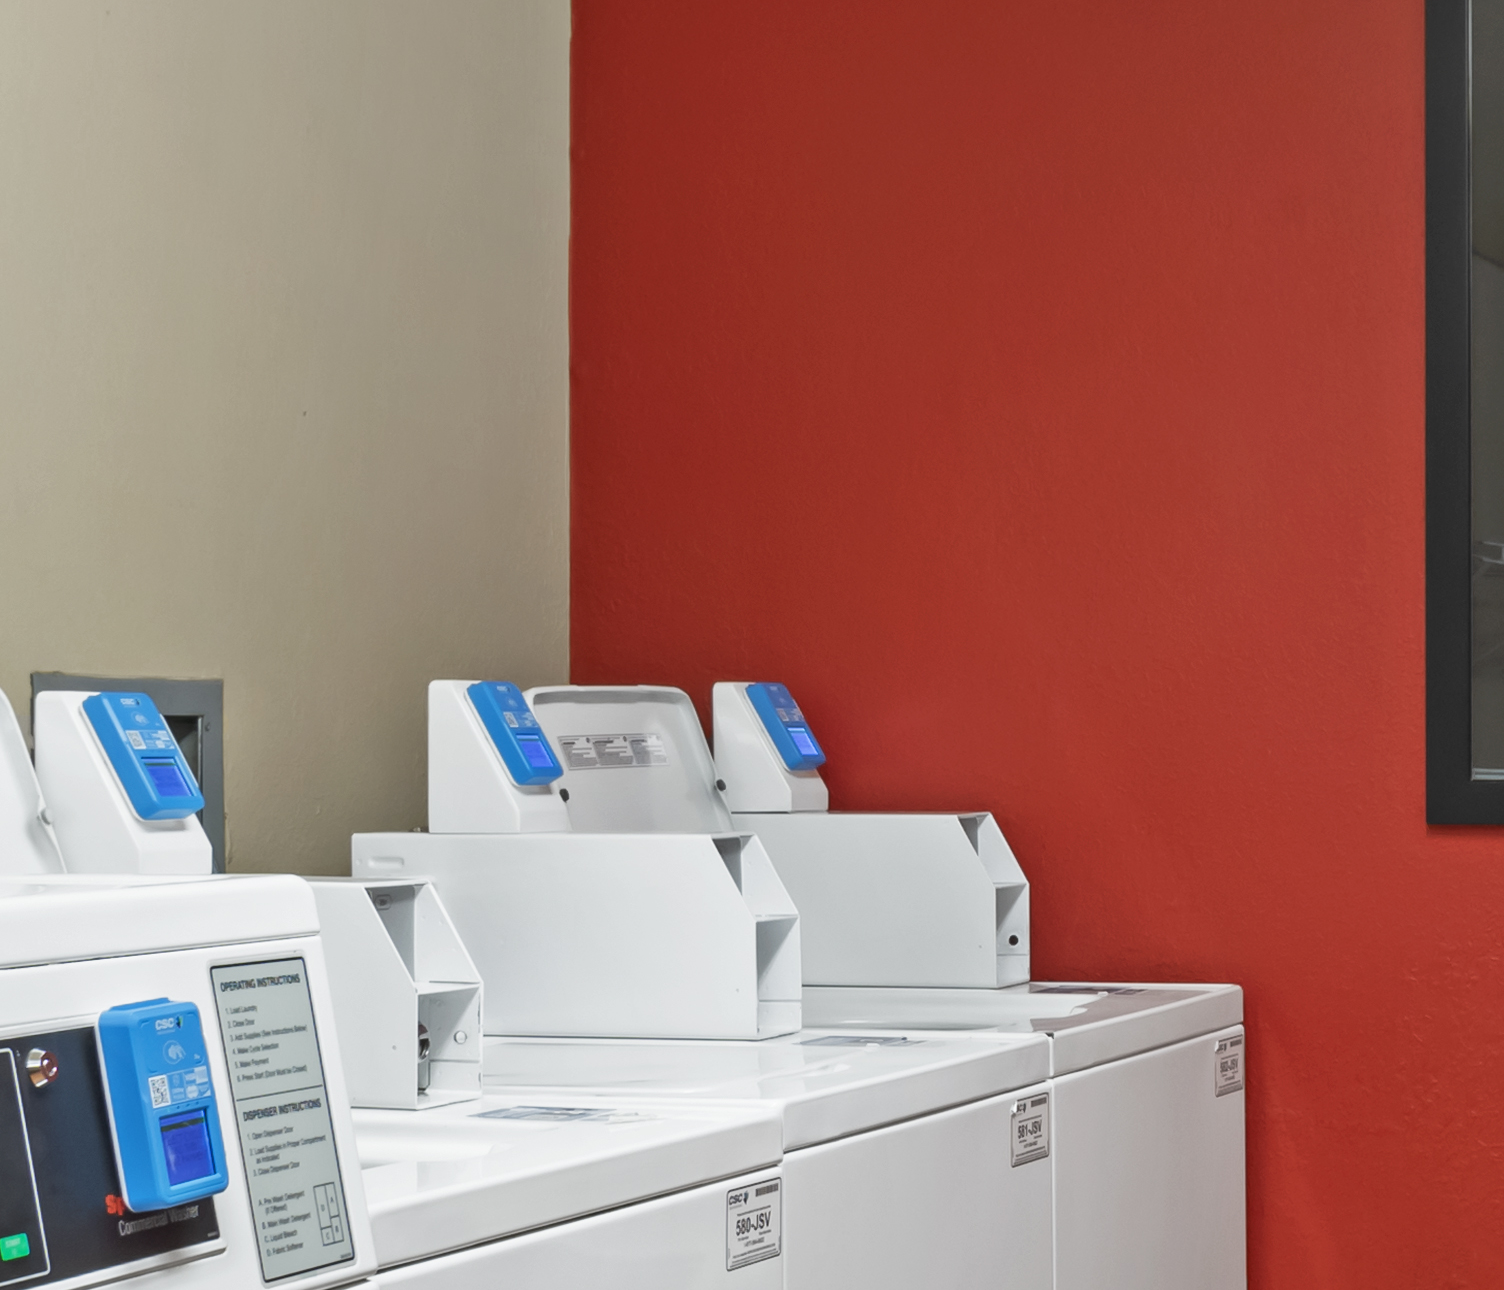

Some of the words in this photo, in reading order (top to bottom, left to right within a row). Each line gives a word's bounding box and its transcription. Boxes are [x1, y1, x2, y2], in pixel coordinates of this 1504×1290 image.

[220, 978, 257, 993] OPERATING
[257, 973, 300, 988] INSTRUCTIONS
[155, 1017, 175, 1031] CSC
[243, 1106, 278, 1122] DISPENSER
[278, 1098, 321, 1115] INSTRUCTIONS
[118, 1210, 168, 1237] Commercial
